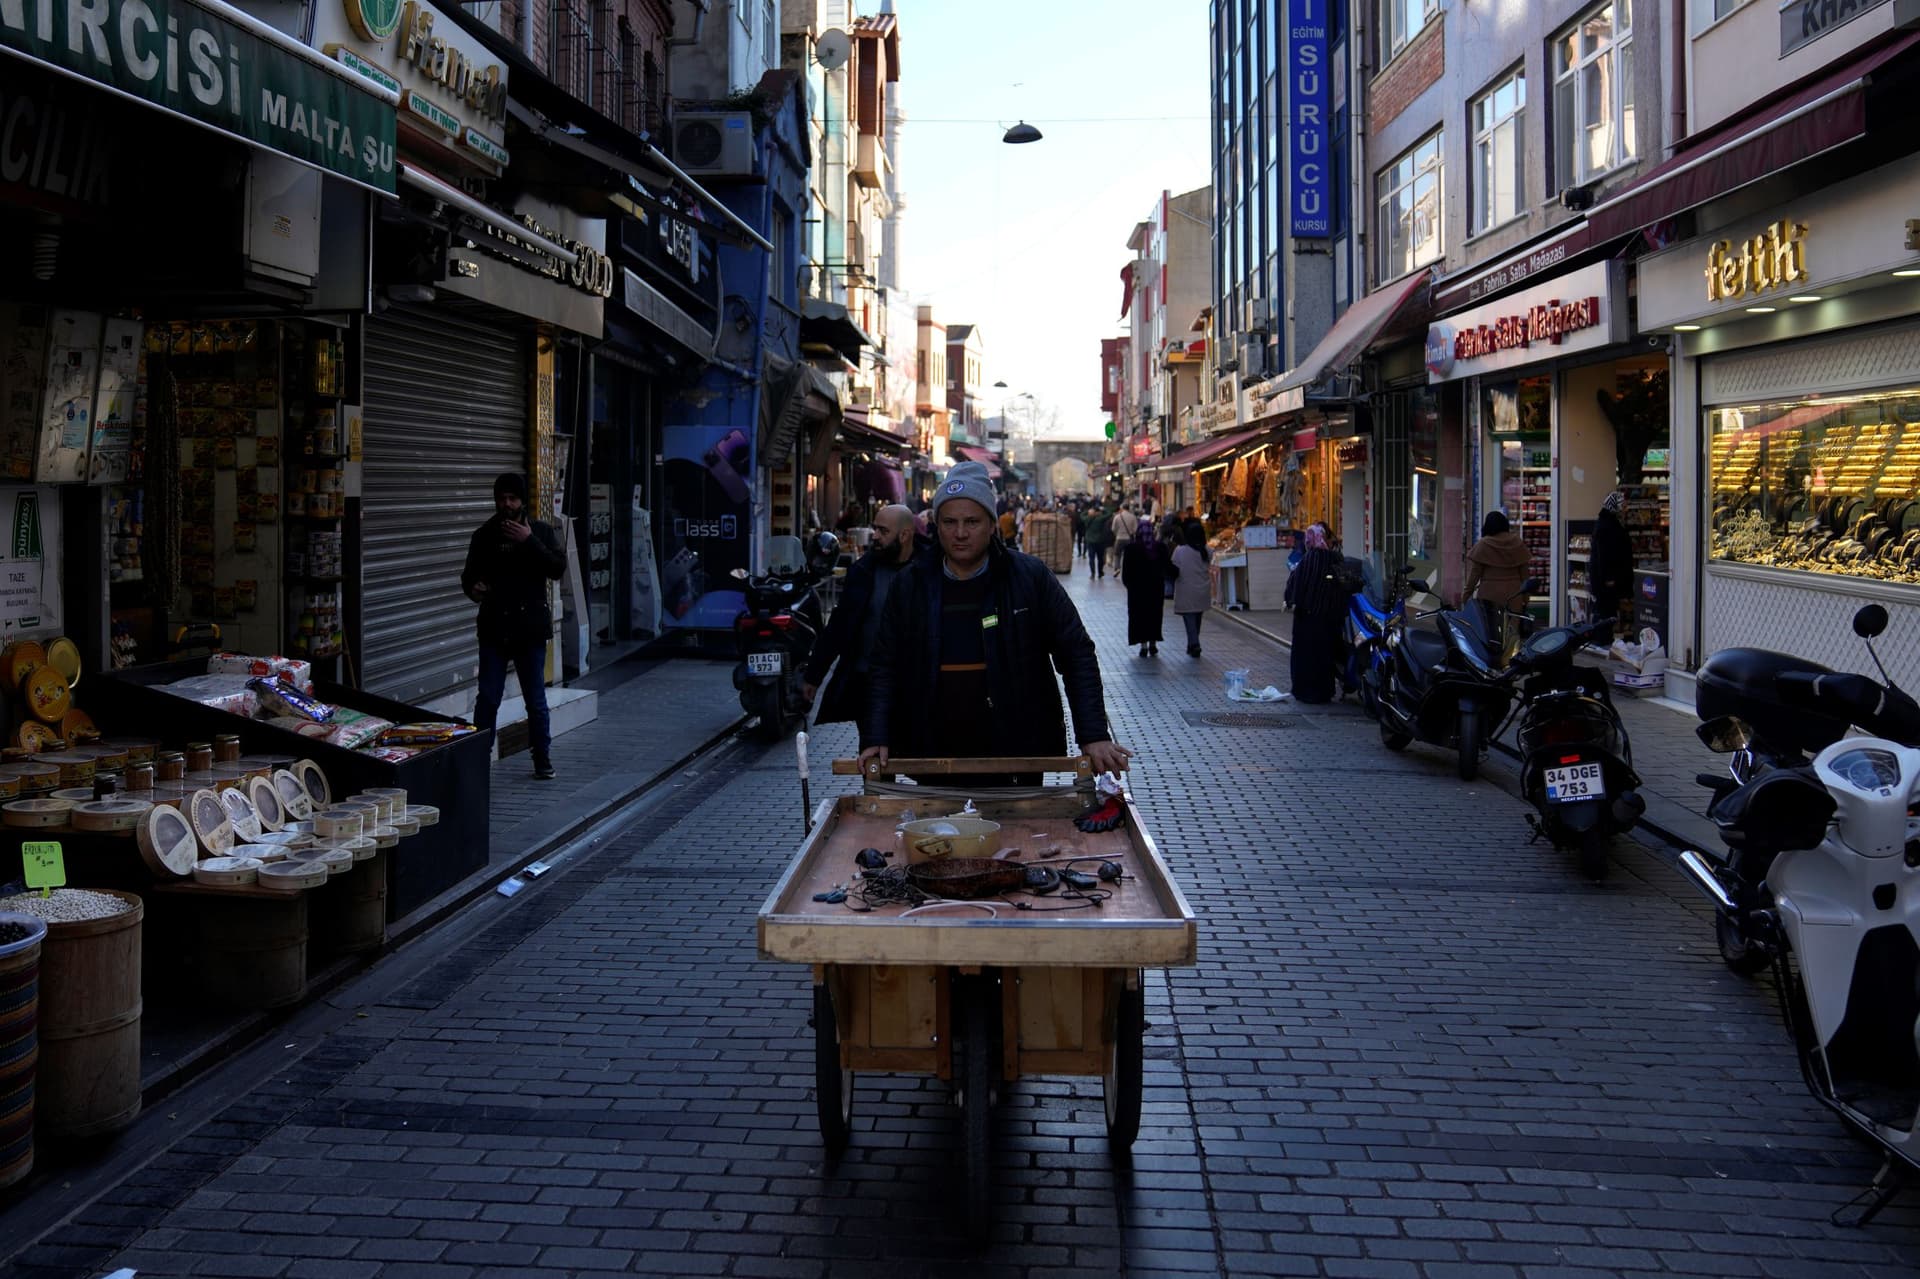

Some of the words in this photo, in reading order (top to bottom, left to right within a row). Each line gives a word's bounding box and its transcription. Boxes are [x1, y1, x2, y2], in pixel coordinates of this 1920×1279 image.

[1292, 25, 1325, 39] EĞİTİM
[261, 87, 355, 160] MALTA
[362, 135, 393, 174] ŞU
[1298, 44, 1321, 215] SÜRÜCÜ
[1294, 220, 1327, 232] KURSU
[570, 240, 614, 299] GOLD
[757, 663, 773, 672] 573
[1547, 770, 1566, 783] 34
[1570, 765, 1599, 780] DGE
[1560, 781, 1588, 796] 753
